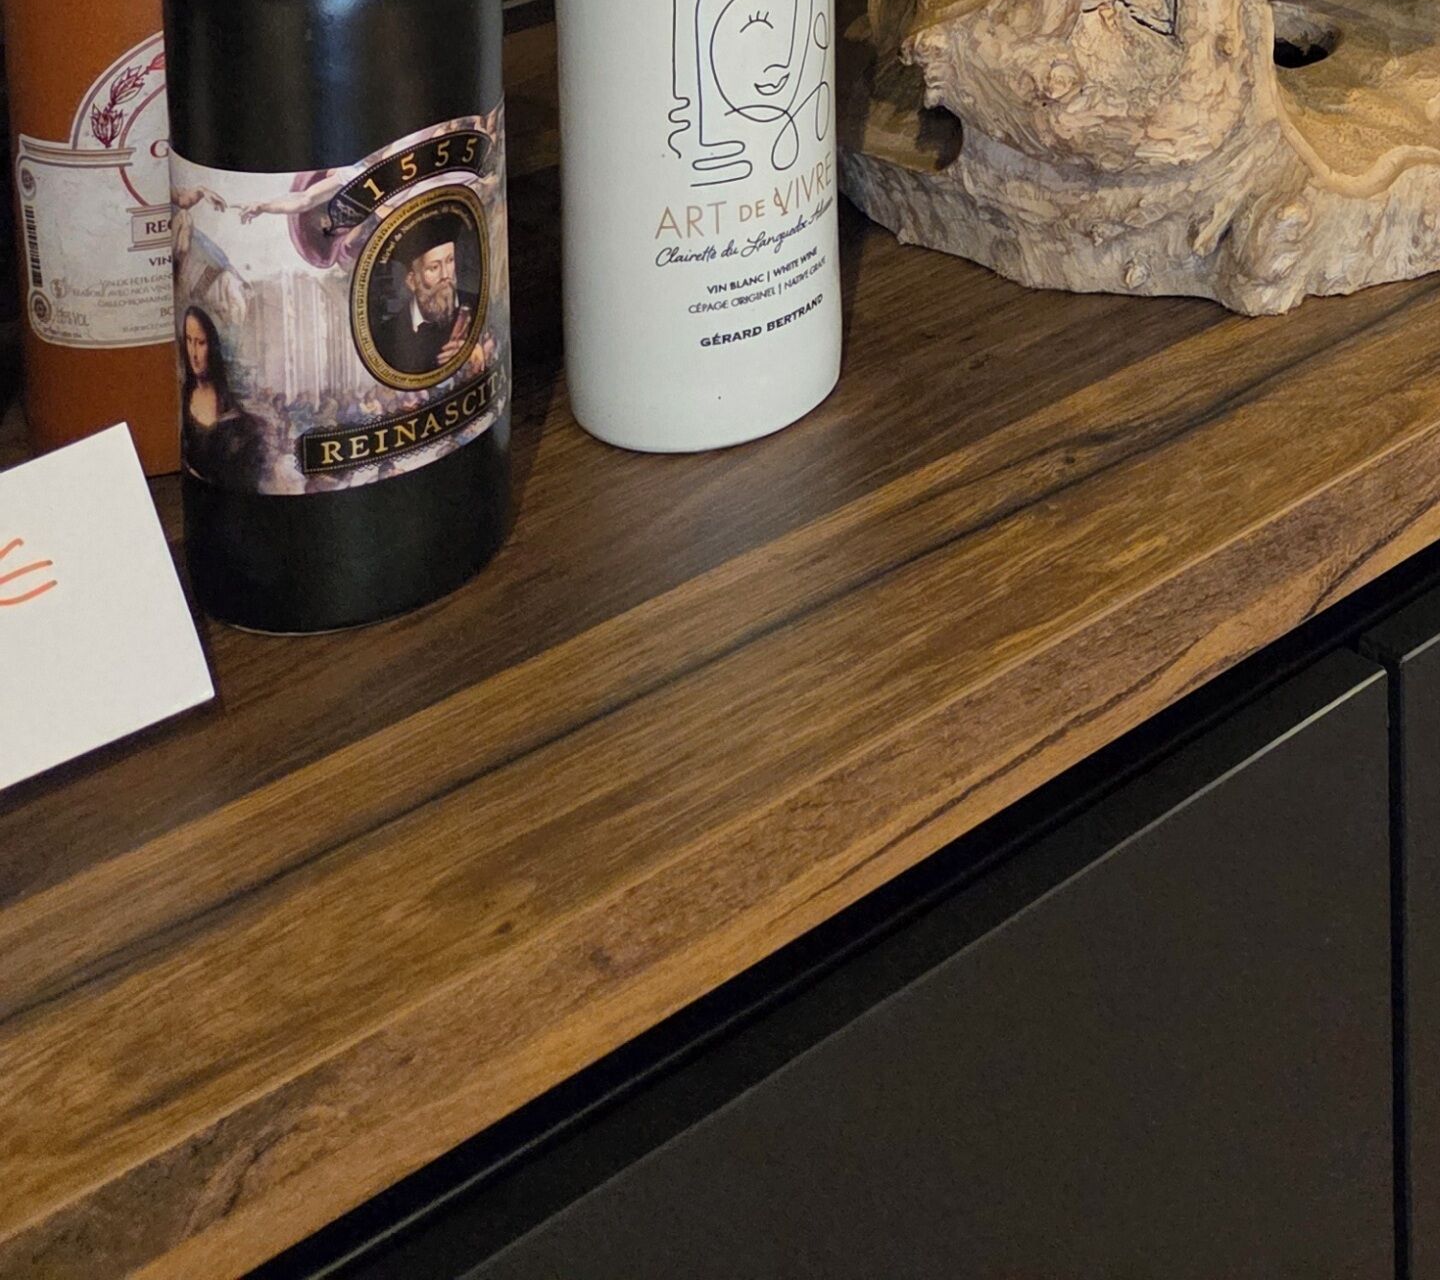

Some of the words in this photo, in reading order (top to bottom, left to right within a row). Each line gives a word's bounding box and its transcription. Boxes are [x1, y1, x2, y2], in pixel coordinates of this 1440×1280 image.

[654, 200, 727, 240] ART
[739, 199, 766, 222] DE
[773, 151, 833, 217] VIVRE
[655, 245, 717, 268] Clairette
[720, 239, 740, 258] du
[706, 284, 728, 295] VIN
[729, 273, 765, 291] BLANC
[772, 259, 800, 278] WHITE
[688, 299, 729, 315] CÉPAGE
[700, 325, 763, 348] GÉRARD
[766, 293, 824, 333] BERTRAND
